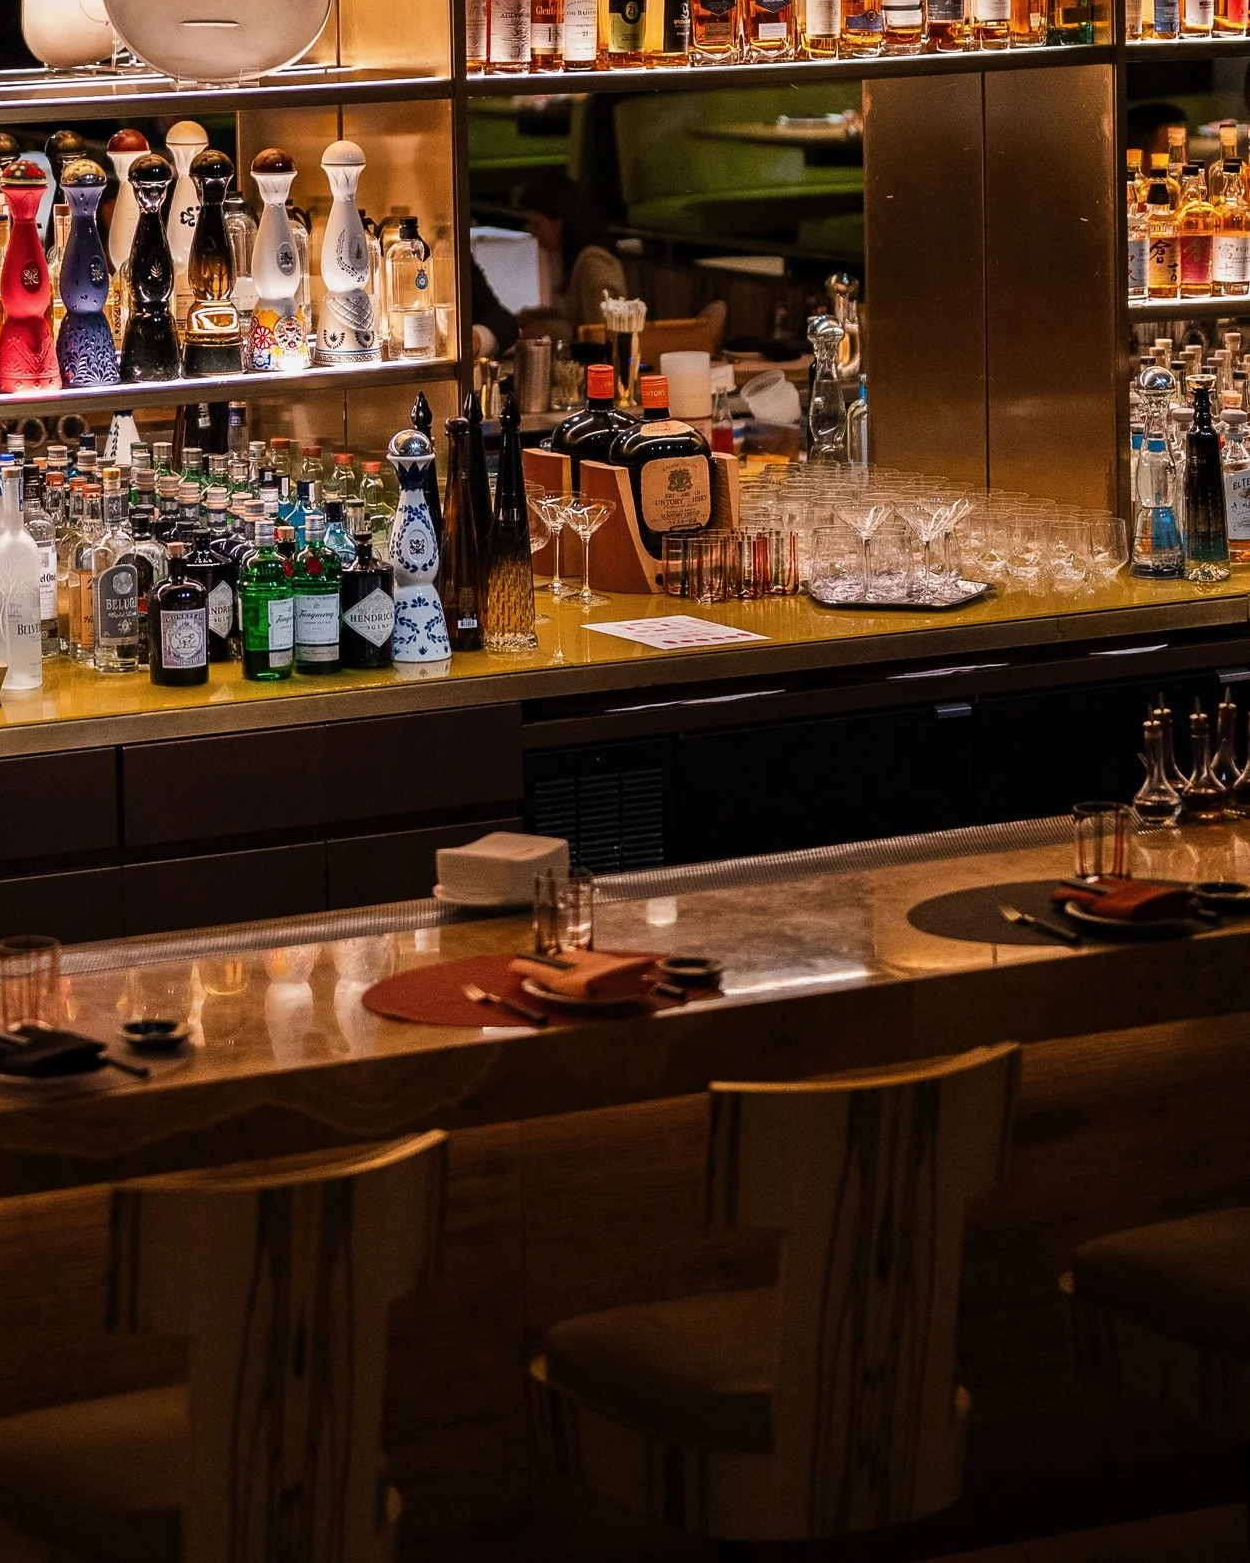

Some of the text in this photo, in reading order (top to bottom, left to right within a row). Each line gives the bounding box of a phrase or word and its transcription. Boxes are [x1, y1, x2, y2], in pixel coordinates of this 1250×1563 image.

[627, 5, 636, 15] 21
[655, 498, 684, 506] UNTORY
[298, 609, 335, 621] Tanqueray
